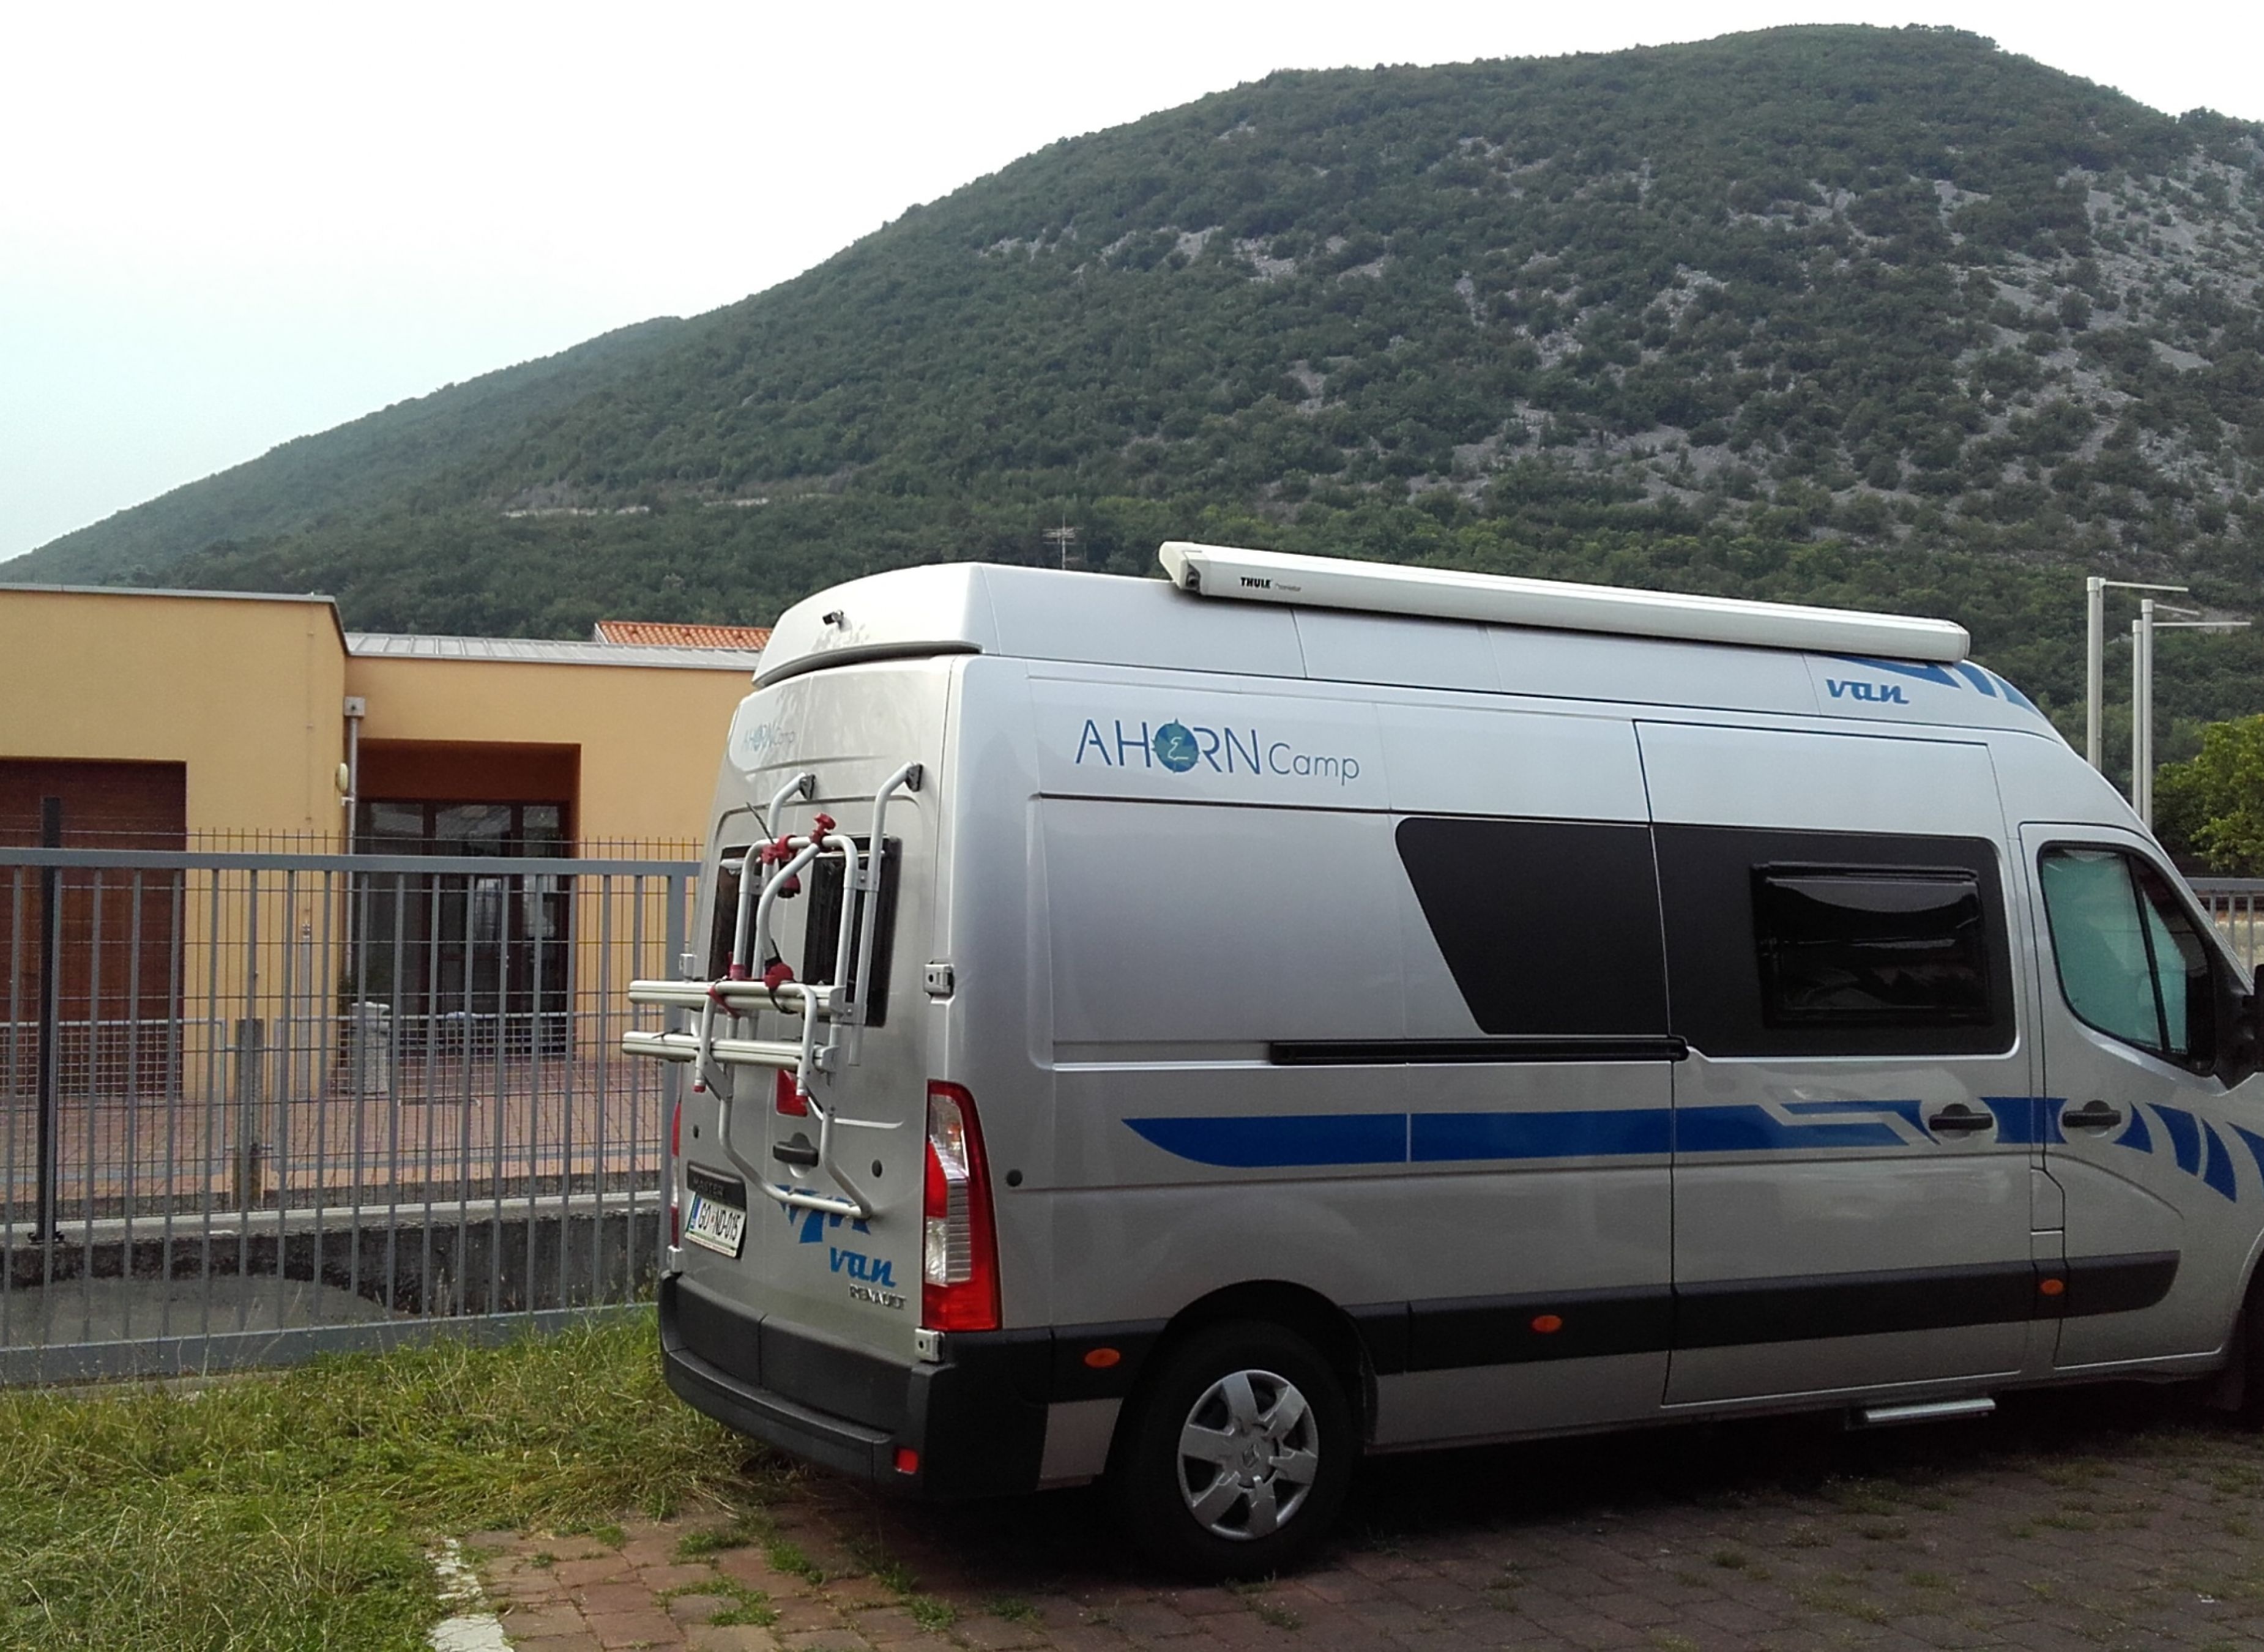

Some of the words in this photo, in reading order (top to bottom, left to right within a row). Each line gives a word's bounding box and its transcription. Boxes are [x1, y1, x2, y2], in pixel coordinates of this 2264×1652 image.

[1240, 577, 1271, 589] THULE
[1826, 679, 1910, 705] van
[1075, 718, 1261, 776] AHORN
[1268, 742, 1360, 786] Camp
[830, 1247, 896, 1288] van
